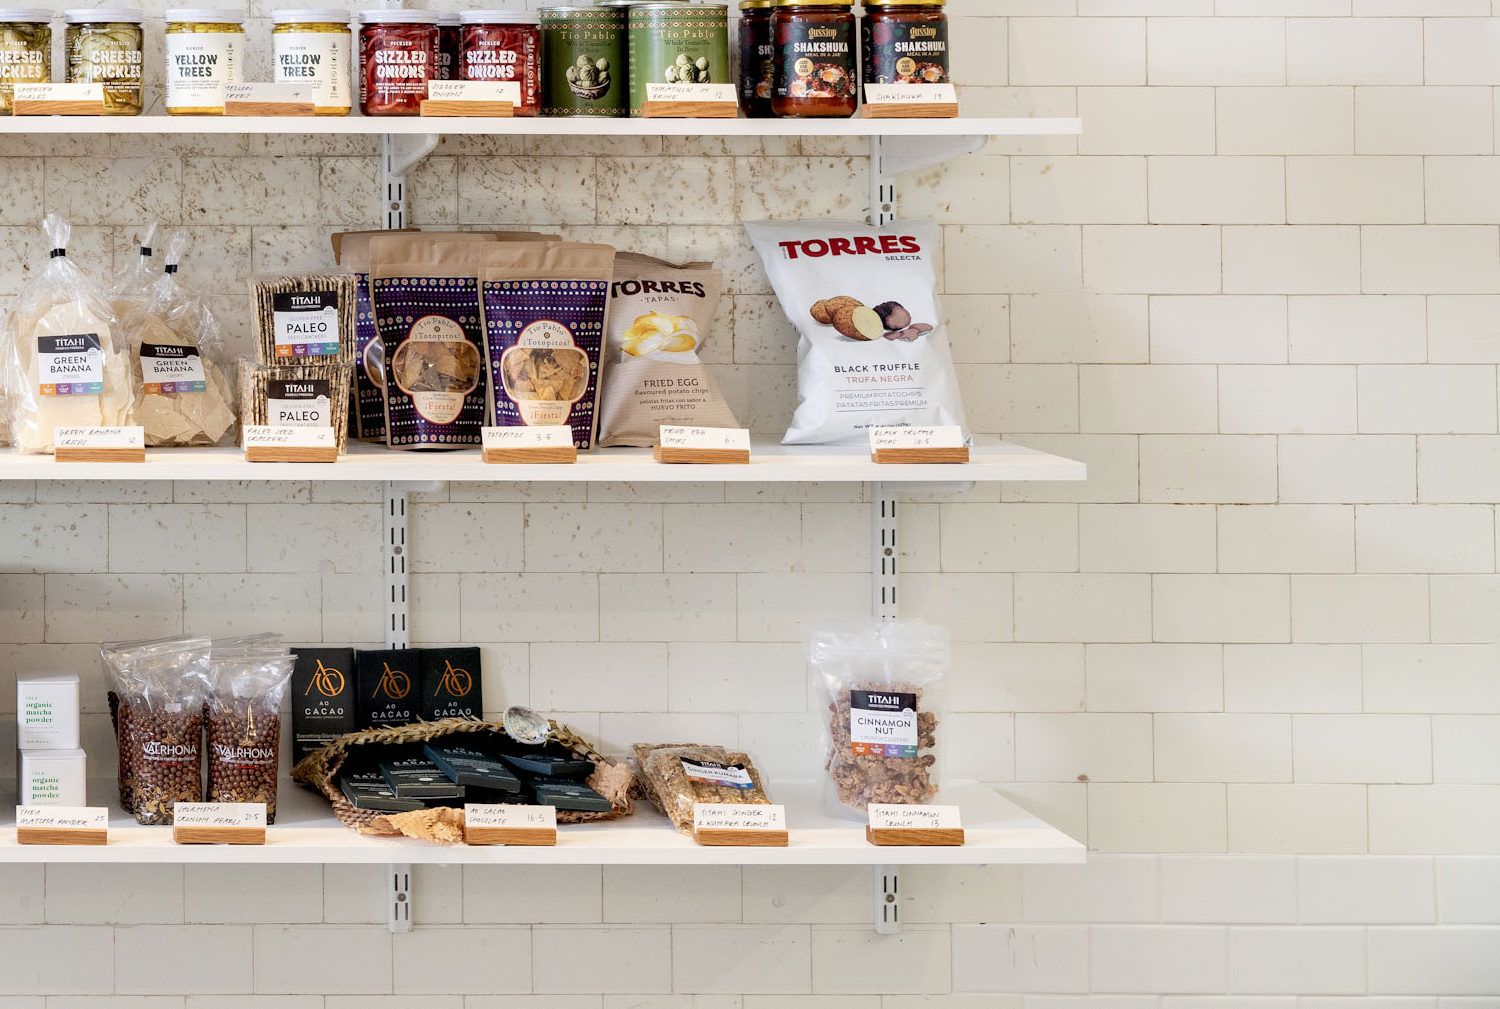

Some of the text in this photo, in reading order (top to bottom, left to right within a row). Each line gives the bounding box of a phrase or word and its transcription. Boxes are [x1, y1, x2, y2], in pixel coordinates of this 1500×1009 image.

[584, 31, 616, 40] Pablo
[684, 29, 716, 38] Pablo
[794, 41, 848, 53] SHAKSHUKA
[894, 41, 946, 52] SHAKSHUKA
[92, 51, 142, 64] CHEESED
[174, 54, 218, 65] YELLOW
[279, 54, 321, 65] YELLOW
[375, 51, 427, 63] SIZZLED
[466, 51, 517, 63] SIZZLED
[92, 65, 140, 79] PICKLES
[179, 67, 212, 77] TREES
[284, 67, 316, 77] TREES
[376, 65, 425, 79] ONIONS
[468, 65, 515, 79] ONIONS
[778, 235, 921, 260] TORRES
[286, 322, 328, 333] PALEO
[54, 357, 87, 365] GREEN
[50, 365, 92, 373] BANANA
[153, 365, 194, 373] BANANA
[834, 363, 920, 373] BLACK TRUFFLE
[644, 379, 699, 389] FRIED EGG
[846, 375, 914, 384] TRUFA NEGRA
[689, 387, 709, 395] chips
[840, 391, 902, 399] PREMIUM POTATO
[894, 399, 928, 407] PREMIUM
[279, 411, 320, 421] PALEO
[59, 429, 122, 437] GREEN BANANA
[26, 701, 52, 709] organic
[372, 711, 410, 719] CACAO
[434, 709, 472, 717] CACAO
[26, 716, 52, 724] powder
[858, 717, 911, 728] CINNAMON
[875, 727, 894, 735] NUT
[860, 735, 909, 743] CRUNCH CLUSTERS
[142, 743, 196, 756] VALRHONA
[219, 745, 274, 758] VALRHONA
[32, 777, 60, 785] organic
[32, 791, 60, 799] powder
[178, 805, 220, 813] VALRHONA
[484, 807, 506, 815] CACAO
[732, 809, 763, 817] GINGER
[768, 813, 777, 822] 12
[875, 809, 940, 819] TITAHI CINNAMON
[20, 817, 54, 825] MATCHA
[56, 818, 88, 827] POWDER
[470, 817, 508, 825] CHOCOLATE
[886, 819, 940, 827] CRUNCH 13
